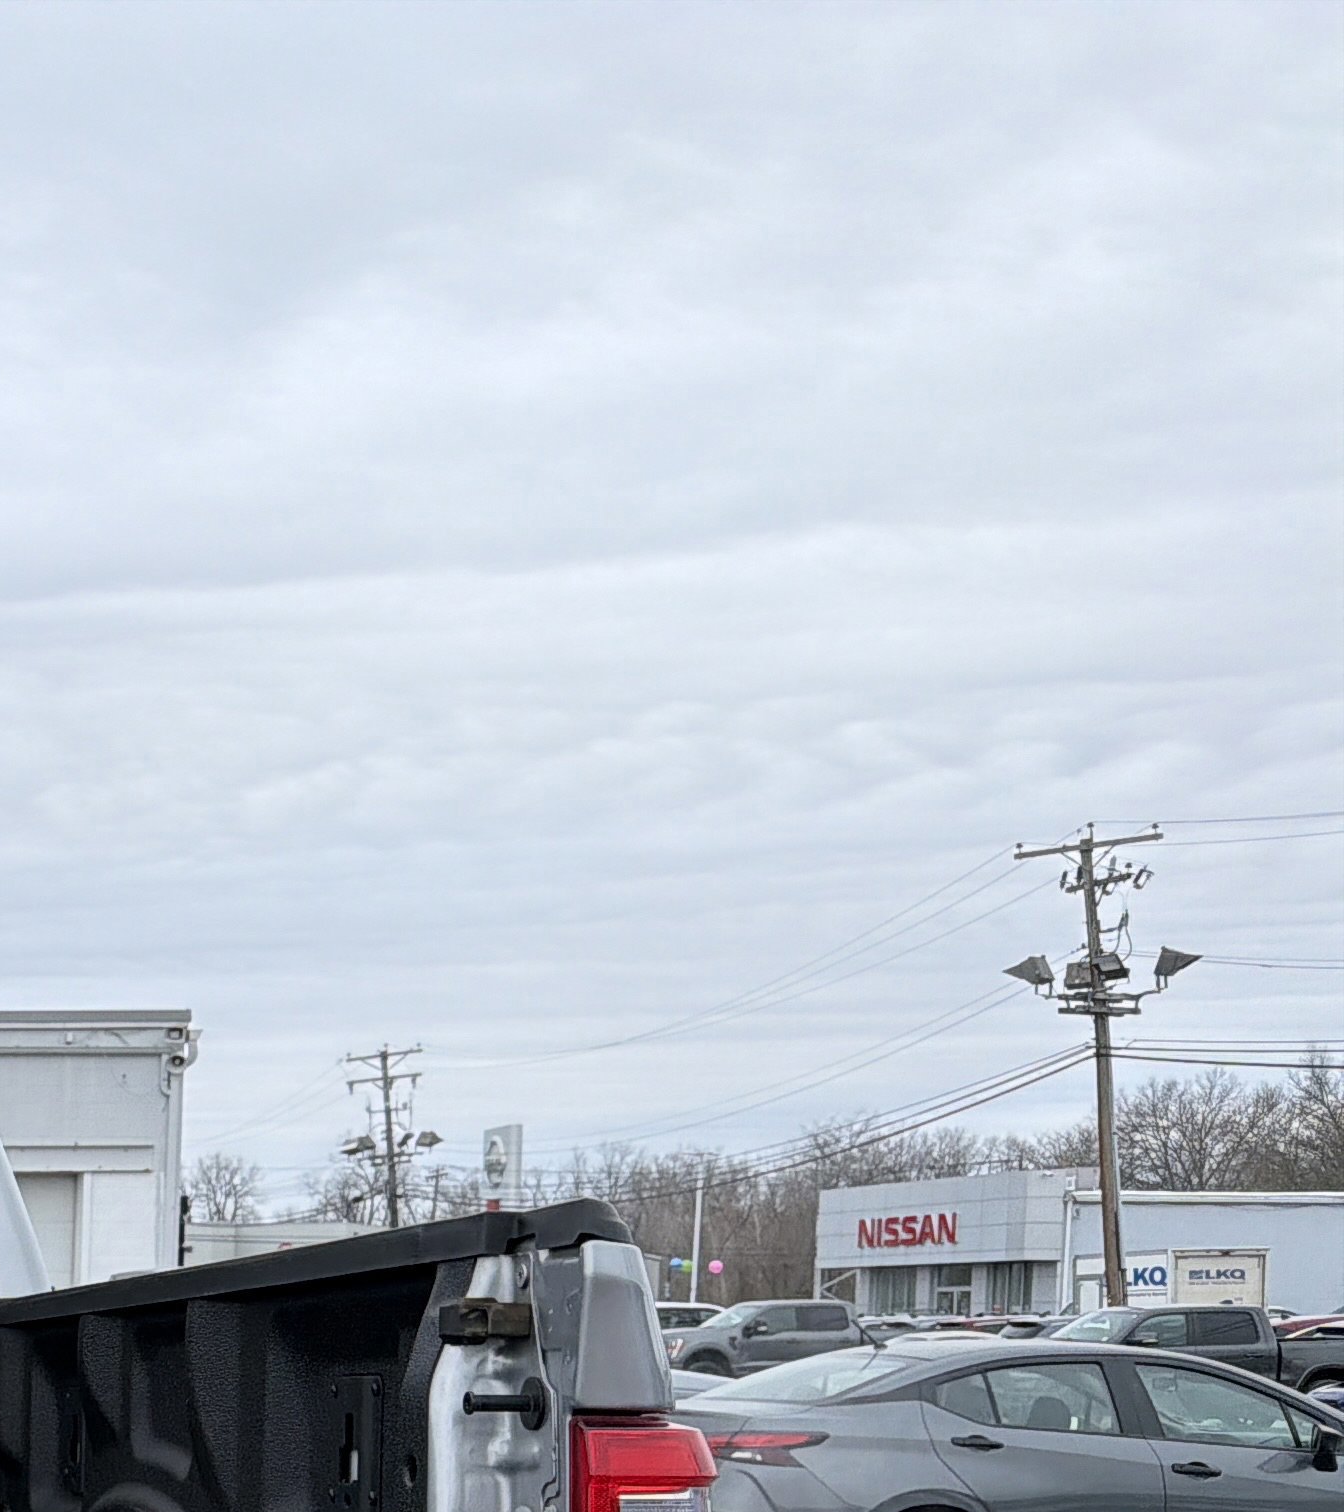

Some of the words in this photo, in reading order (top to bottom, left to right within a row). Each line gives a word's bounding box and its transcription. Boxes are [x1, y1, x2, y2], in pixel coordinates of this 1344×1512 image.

[857, 1212, 958, 1249] NISSAN
[1126, 1265, 1168, 1287] KQ
[1204, 1268, 1246, 1281] LKQ
